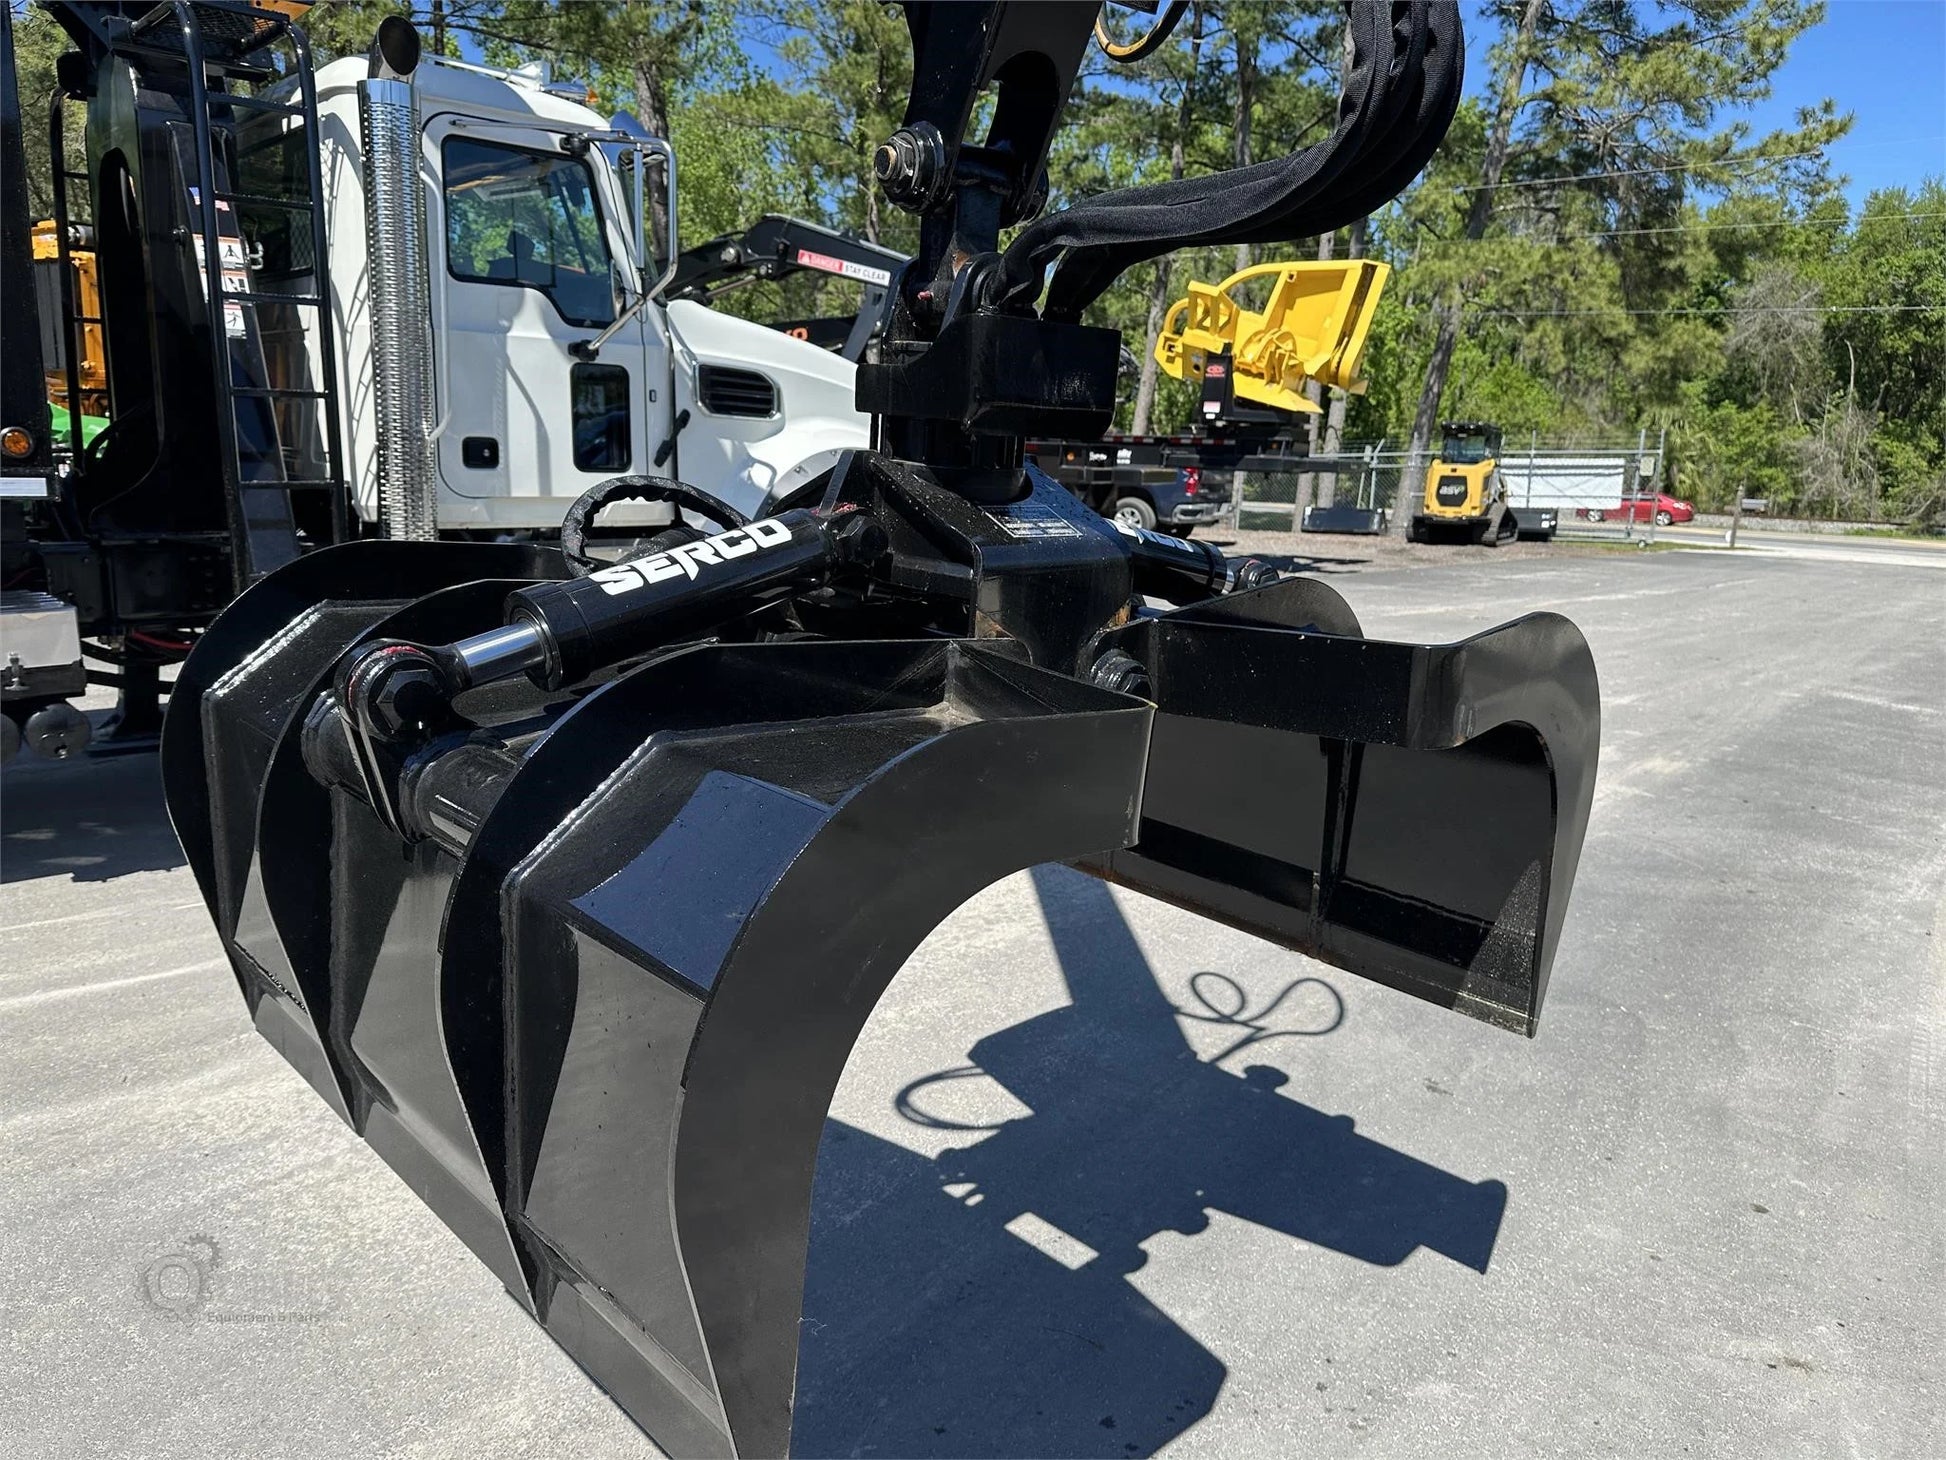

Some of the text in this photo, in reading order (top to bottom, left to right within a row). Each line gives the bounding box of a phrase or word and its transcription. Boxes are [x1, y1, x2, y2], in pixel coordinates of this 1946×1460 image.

[845, 264, 861, 276] STAY
[862, 268, 886, 281] CLEAR
[588, 518, 793, 596] SERCO
